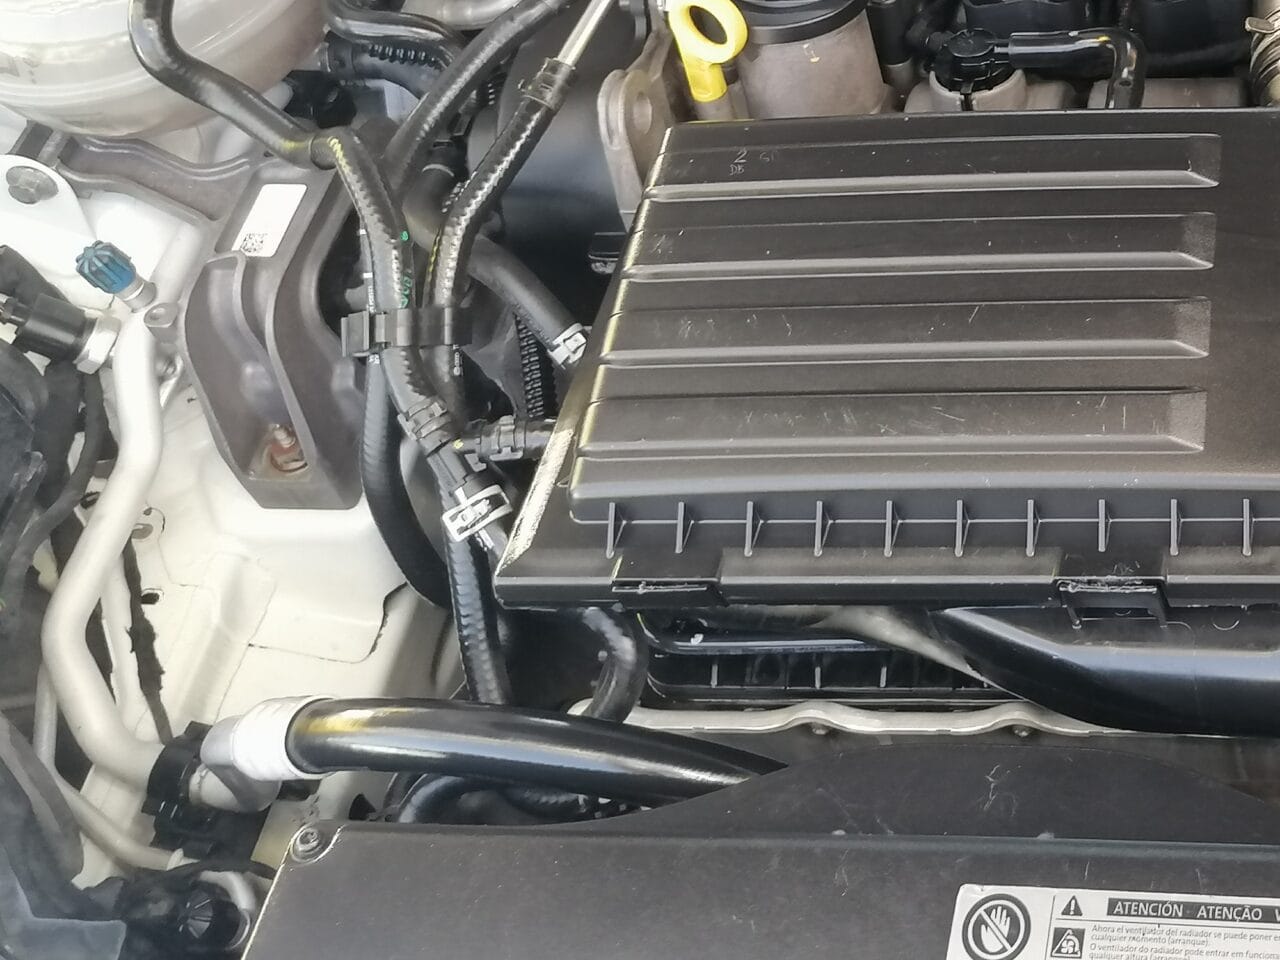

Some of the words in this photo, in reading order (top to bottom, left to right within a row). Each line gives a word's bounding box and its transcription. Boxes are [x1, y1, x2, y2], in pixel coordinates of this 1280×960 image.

[1113, 900, 1184, 917] ATENCIÓN
[1196, 905, 1263, 922] ATENÇÃO
[1091, 933, 1127, 943] cualquier
[1092, 924, 1115, 933] Ahora
[1116, 925, 1124, 933] el
[1165, 927, 1178, 936] del
[1179, 929, 1212, 938] radiador
[1223, 932, 1248, 941] puede
[1249, 934, 1272, 942] poner
[1098, 944, 1137, 953] ventilador
[1138, 945, 1149, 954] do
[1150, 946, 1184, 955] radiador
[1184, 948, 1204, 957] pode
